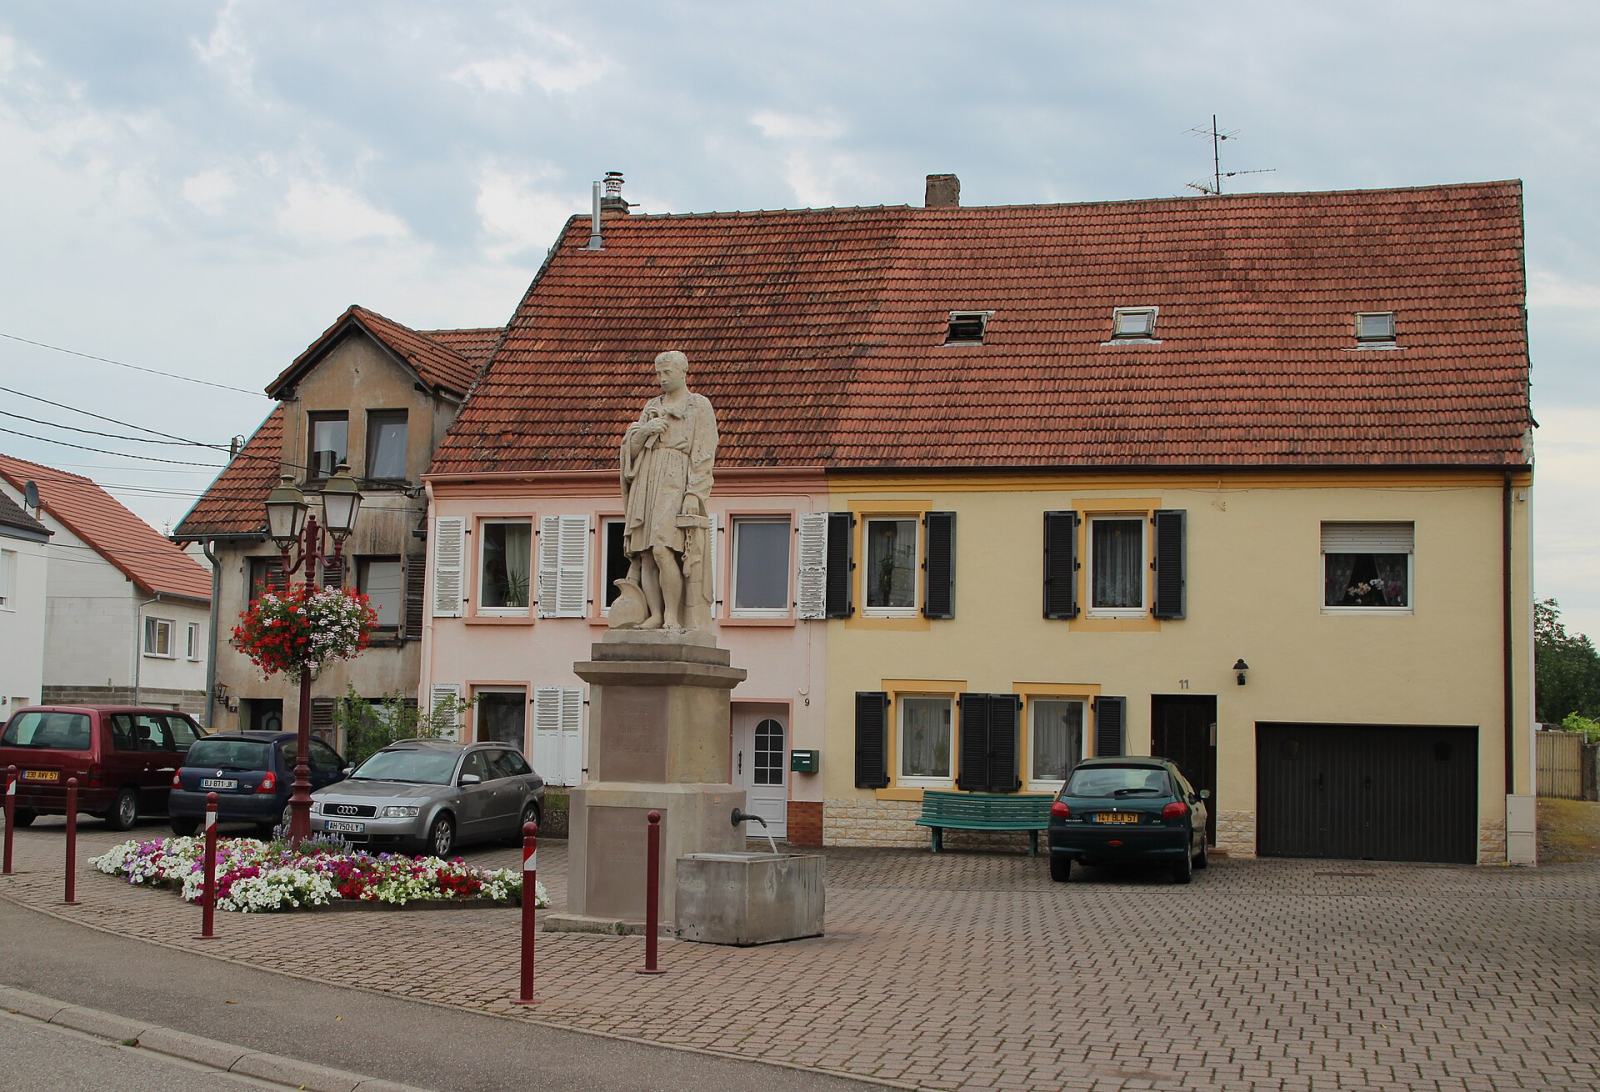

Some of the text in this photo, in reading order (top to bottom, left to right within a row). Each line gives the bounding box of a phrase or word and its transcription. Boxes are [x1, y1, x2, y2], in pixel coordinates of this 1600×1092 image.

[1178, 679, 1189, 690] 11
[804, 698, 810, 706] 9
[1098, 813, 1109, 822] 147
[1127, 813, 1136, 822] 57
